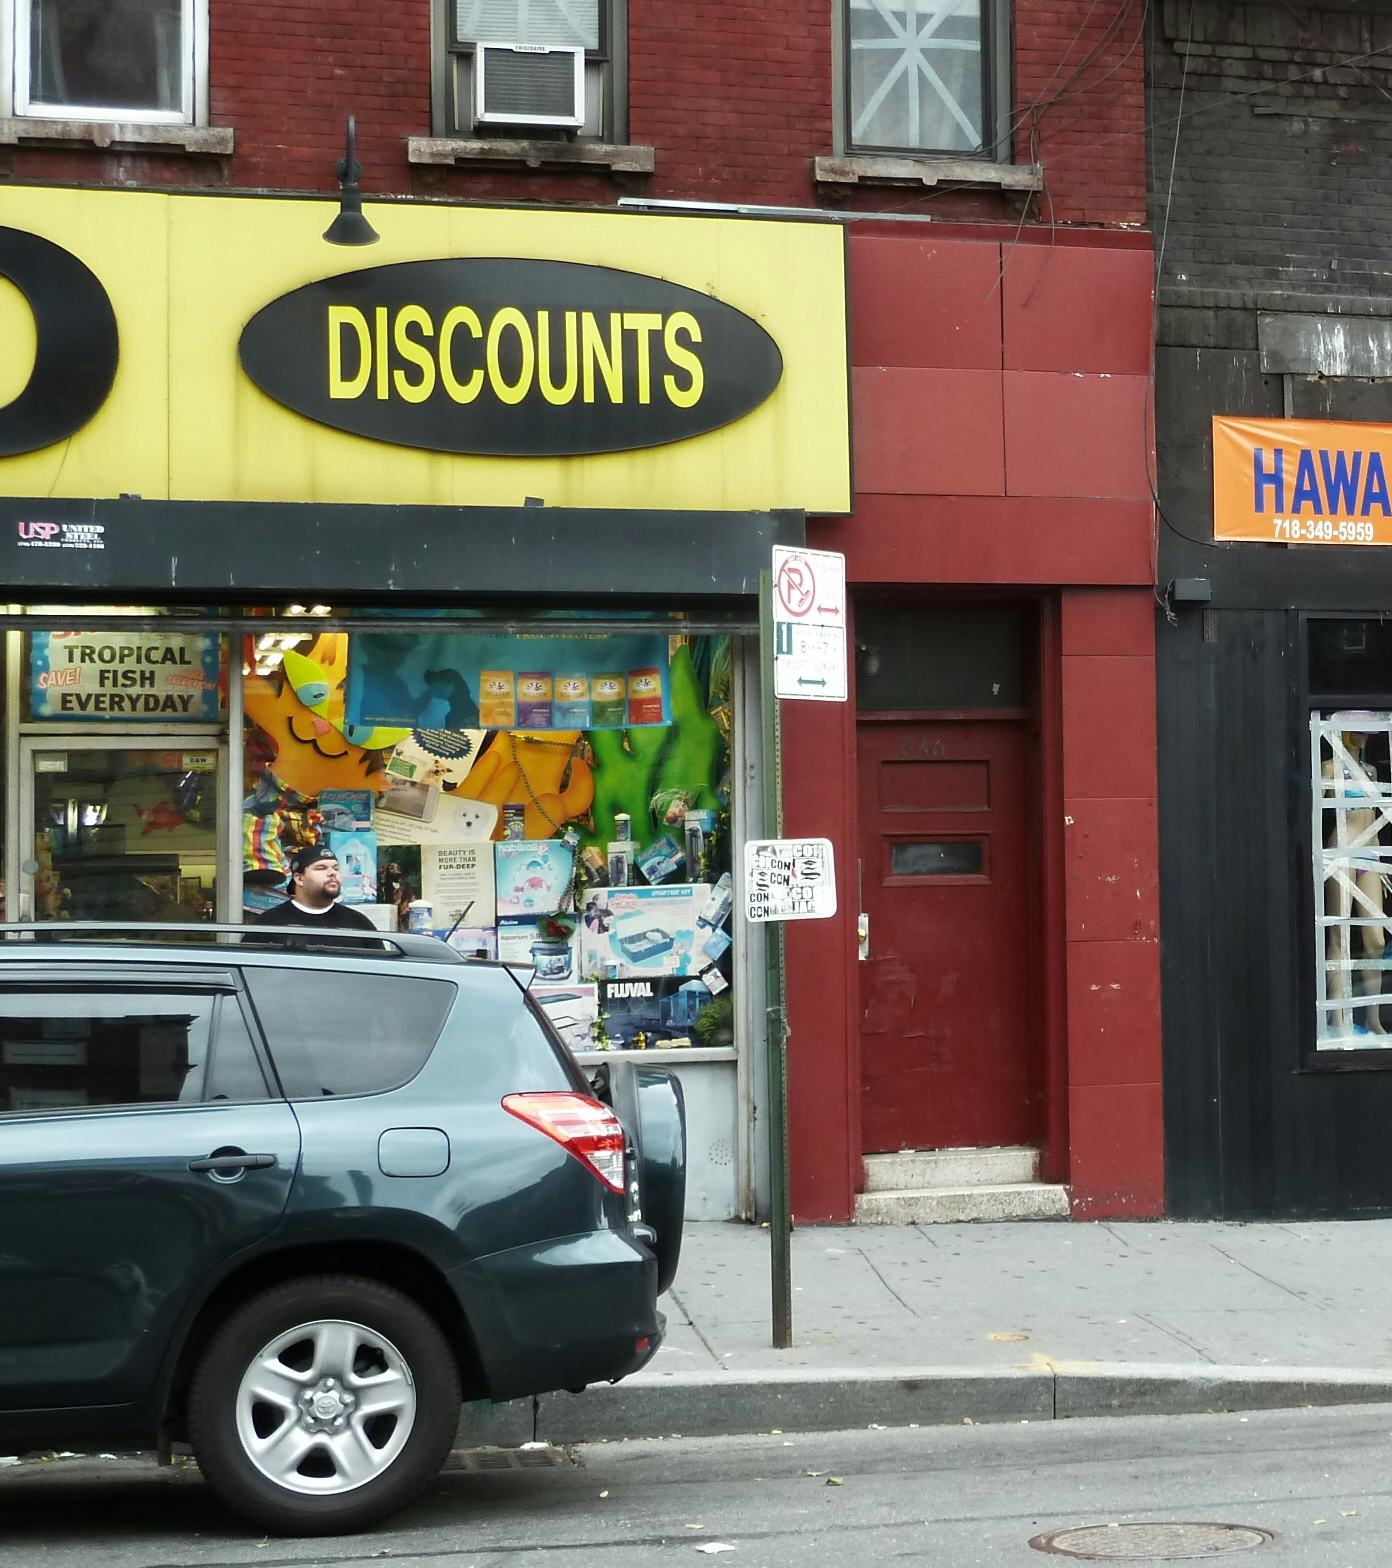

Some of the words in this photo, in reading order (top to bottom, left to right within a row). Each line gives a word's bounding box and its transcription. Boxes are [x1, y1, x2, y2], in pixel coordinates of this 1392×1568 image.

[328, 303, 705, 410] DISCOUNTS
[18, 522, 61, 540] USP
[62, 524, 105, 533] UNITED
[65, 532, 101, 540] STEEL
[1272, 518, 1375, 542] 718-349-5959
[63, 645, 192, 666] TROPICAL
[37, 667, 82, 690] SAVE!
[99, 669, 156, 688] FISH
[60, 692, 195, 713] EVERYDAY
[438, 849, 467, 857] BEAUTY
[438, 856, 457, 864] MORE
[438, 863, 477, 871] FUR-DEEP
[770, 858, 791, 871] CON
[769, 872, 791, 887] CON
[749, 892, 769, 902] CON
[749, 906, 770, 919] CON
[606, 982, 654, 998] FLUVAL
